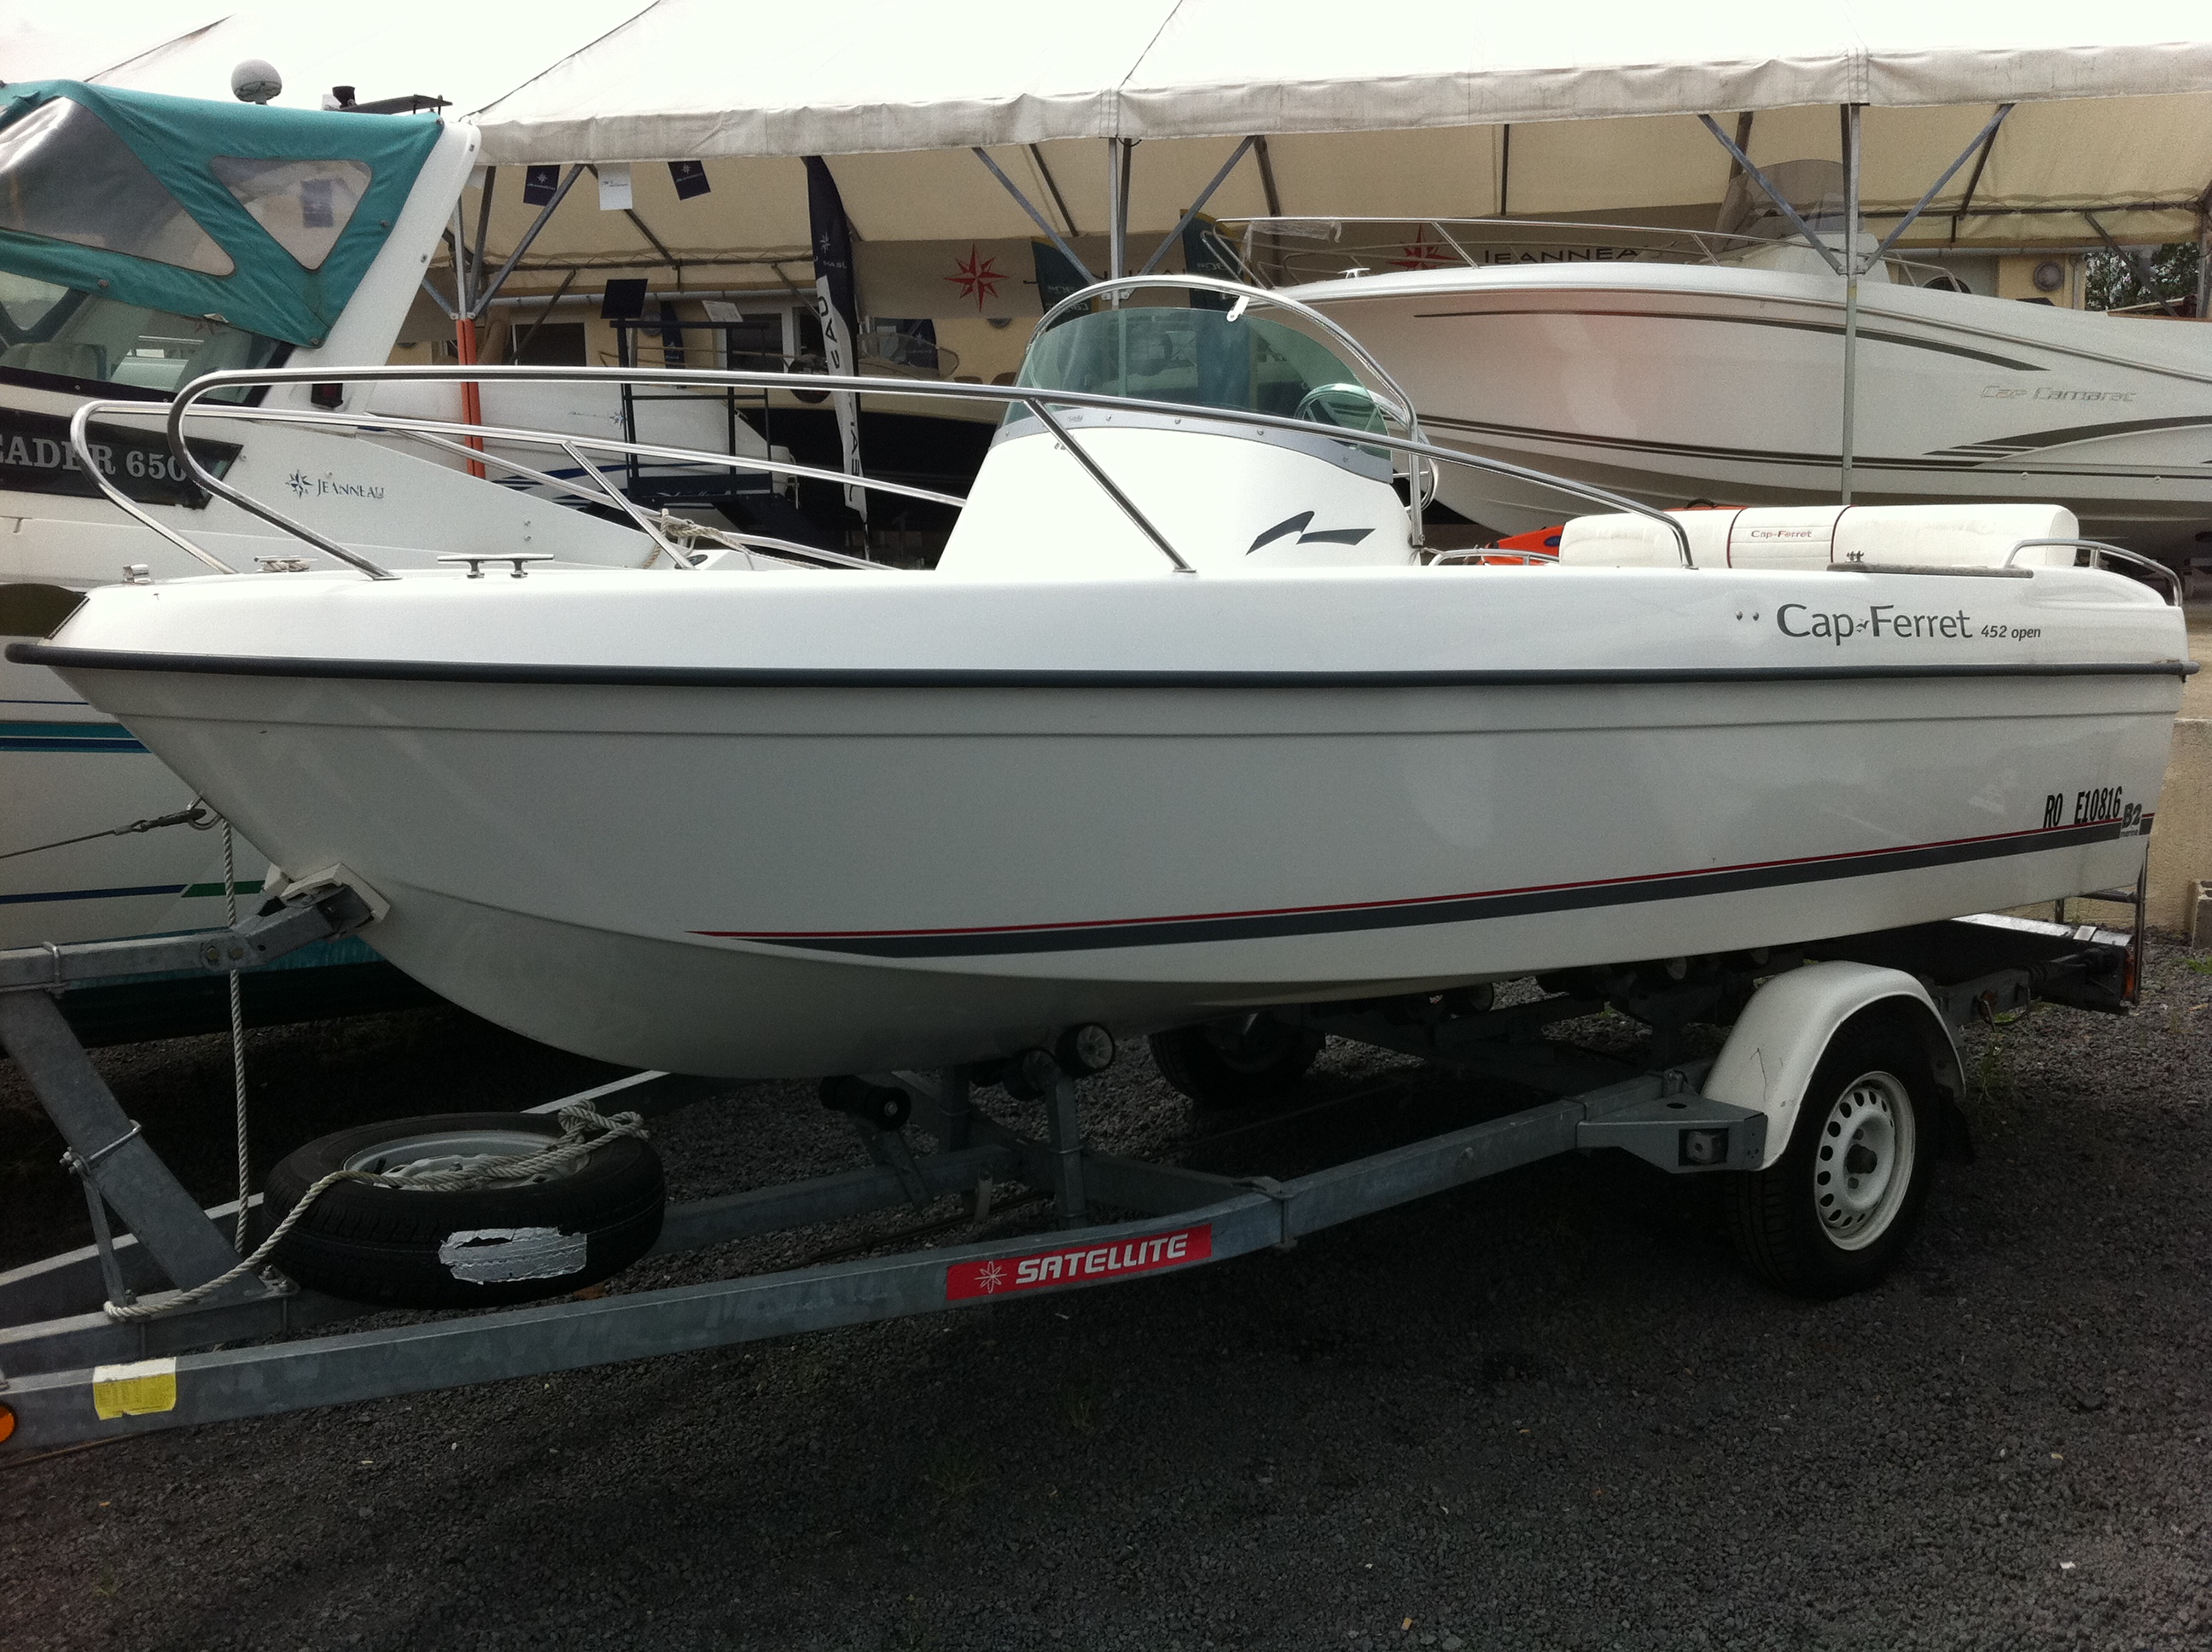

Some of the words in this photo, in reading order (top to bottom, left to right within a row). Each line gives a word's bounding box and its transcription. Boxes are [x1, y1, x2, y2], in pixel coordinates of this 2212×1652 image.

[1980, 386, 2028, 398] Cap
[317, 479, 384, 499] JEANNEAU
[1750, 530, 1813, 539] Cap-Ferret
[1981, 625, 2007, 638] 452
[2011, 628, 2041, 642] open
[2074, 786, 2122, 824] E10816
[2122, 802, 2142, 829] B2
[1016, 1233, 1189, 1285] SATELLITE
